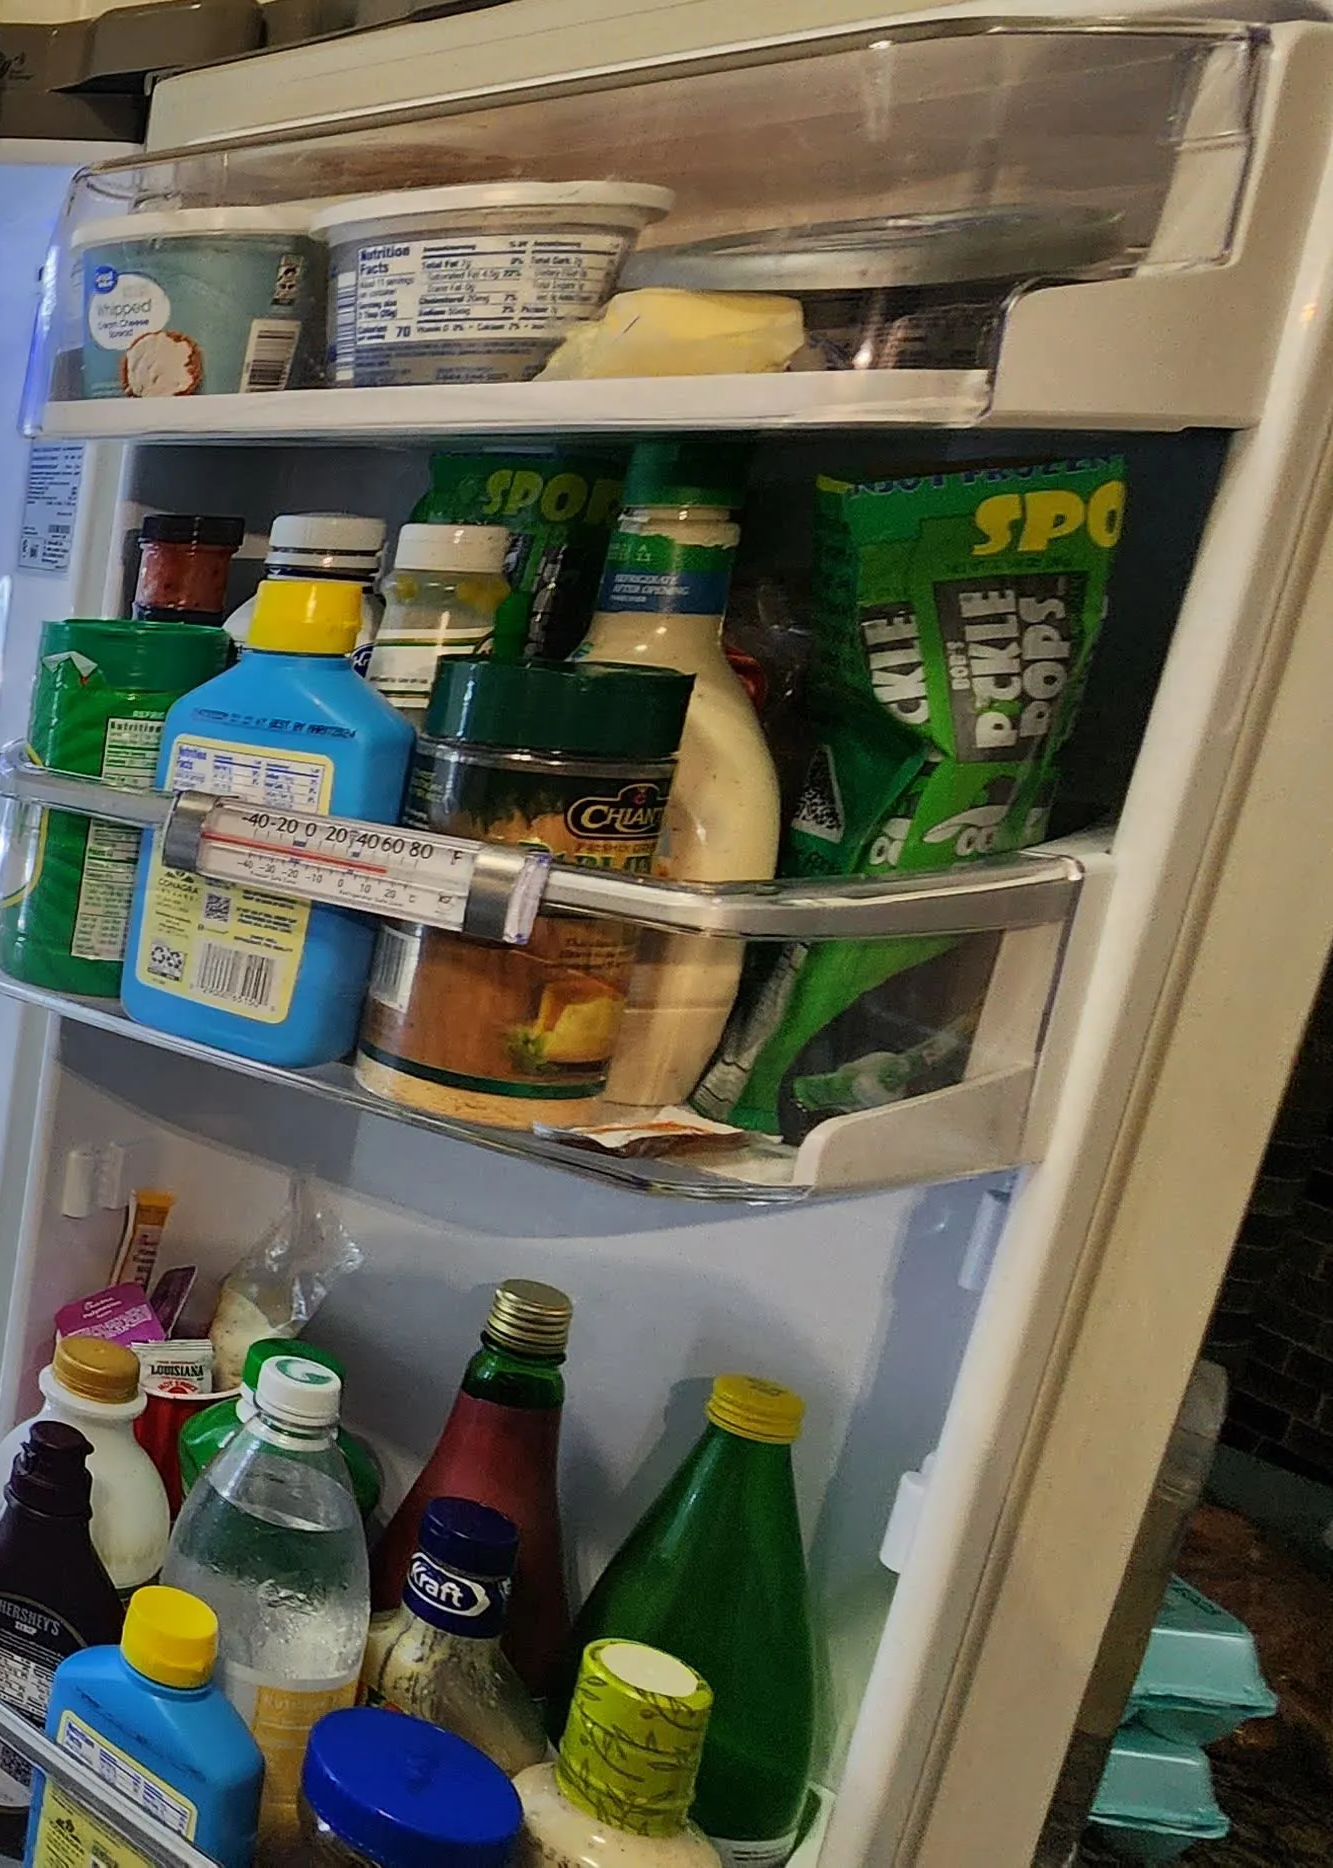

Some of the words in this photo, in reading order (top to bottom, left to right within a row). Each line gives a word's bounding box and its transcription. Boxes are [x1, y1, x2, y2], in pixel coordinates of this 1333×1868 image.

[359, 246, 410, 261] Nutrition
[359, 262, 389, 276] Facts
[96, 298, 152, 319] whipped
[396, 325, 411, 338] 70
[641, 584, 691, 596] OPENING
[241, 813, 270, 829] -40
[271, 816, 298, 835] -20
[305, 822, 317, 837] 0
[325, 825, 347, 843] 20
[356, 832, 379, 849] 40
[381, 837, 405, 854] 60
[409, 840, 433, 860] 80
[450, 848, 463, 866] F
[158, 877, 199, 896] CONAGRA
[305, 872, 323, 884] -10
[337, 878, 344, 888] 0
[360, 882, 372, 895] 10
[384, 887, 397, 899] 20
[149, 1364, 205, 1377] LOUISIANA
[410, 1560, 464, 1608] Kraft
